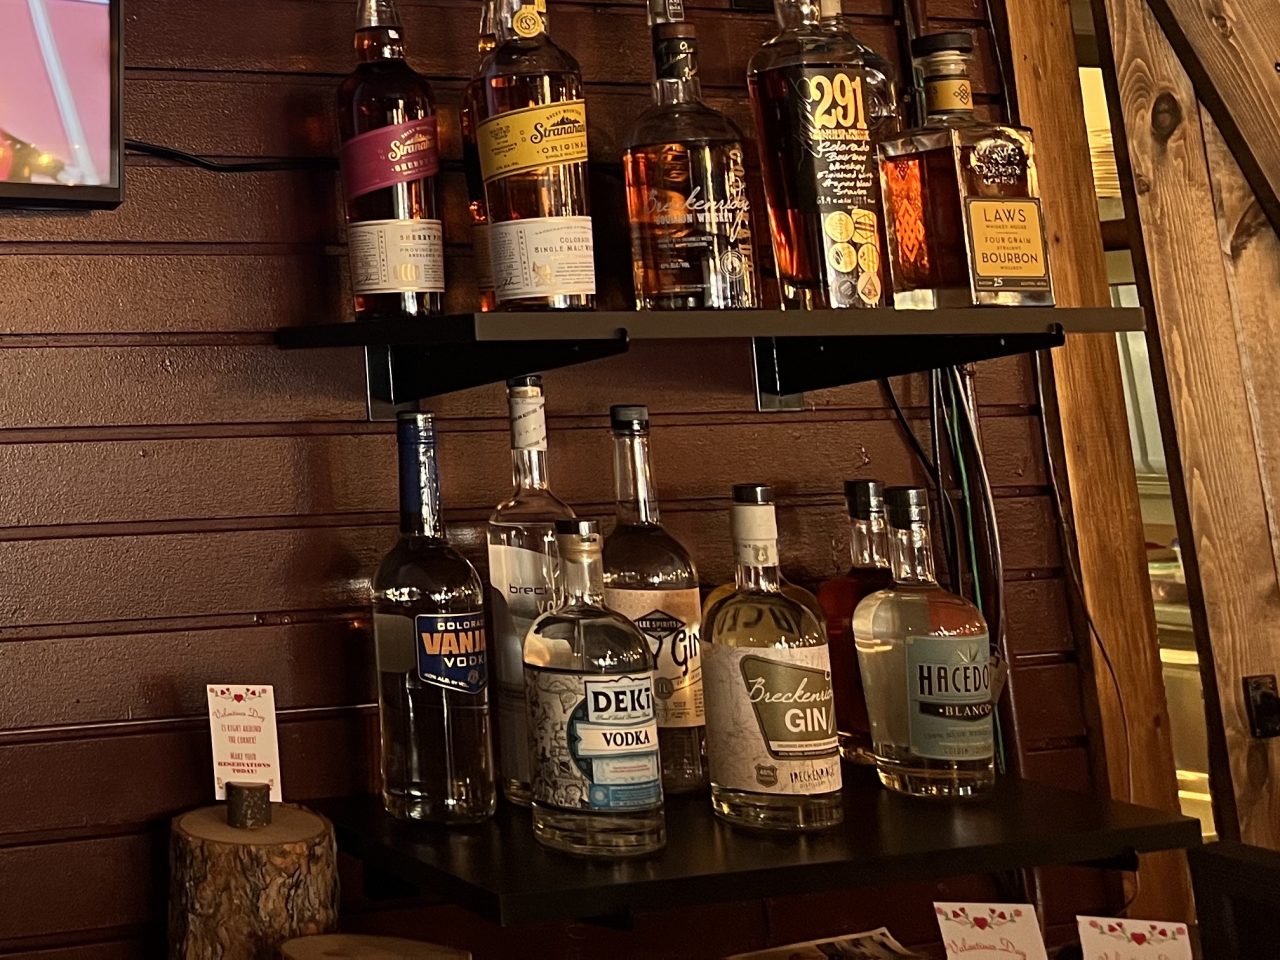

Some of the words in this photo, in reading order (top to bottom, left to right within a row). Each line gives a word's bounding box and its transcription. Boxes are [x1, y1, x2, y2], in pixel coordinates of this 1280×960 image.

[809, 72, 868, 130] 291
[817, 141, 870, 154] Colorado
[983, 208, 1027, 223] LAWS
[984, 236, 1005, 244] FOUR
[1007, 236, 1031, 244] GRAIN
[534, 246, 564, 254] SINGLE
[981, 252, 1038, 264] BOURBON
[944, 704, 990, 717] BLANCO
[784, 706, 828, 733] GIN
[601, 729, 651, 747] VODKA
